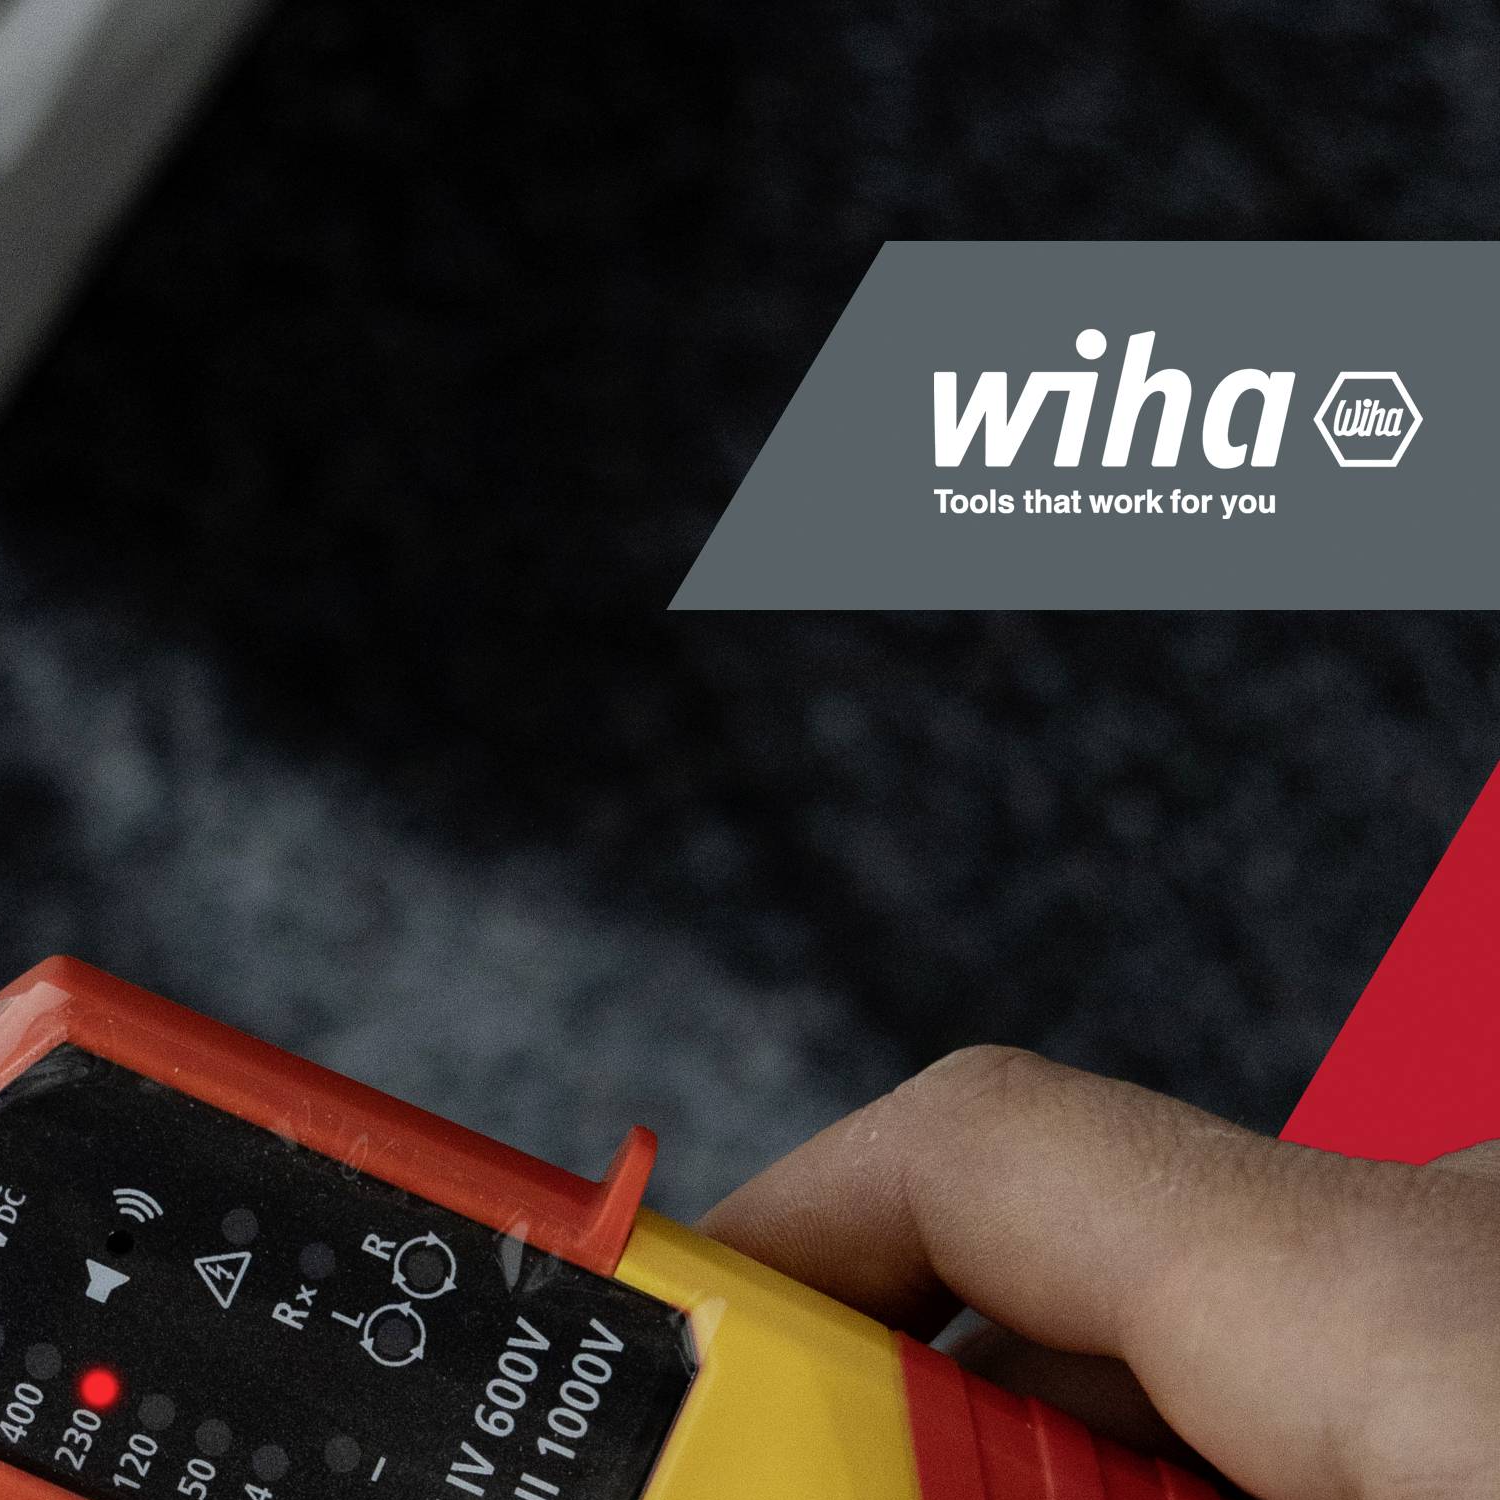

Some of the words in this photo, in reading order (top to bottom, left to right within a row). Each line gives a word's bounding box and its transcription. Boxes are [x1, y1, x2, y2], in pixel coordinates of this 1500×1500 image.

[361, 1233, 397, 1261] R
[271, 1284, 318, 1330] Rx
[331, 1310, 365, 1329] L
[0, 1383, 44, 1444] 400
[445, 1441, 495, 1497] IV
[474, 1315, 551, 1437] 600V
[537, 1317, 624, 1460] 1000V
[55, 1408, 102, 1471] 230
[113, 1433, 158, 1490] 120
[177, 1458, 216, 1500] 50
